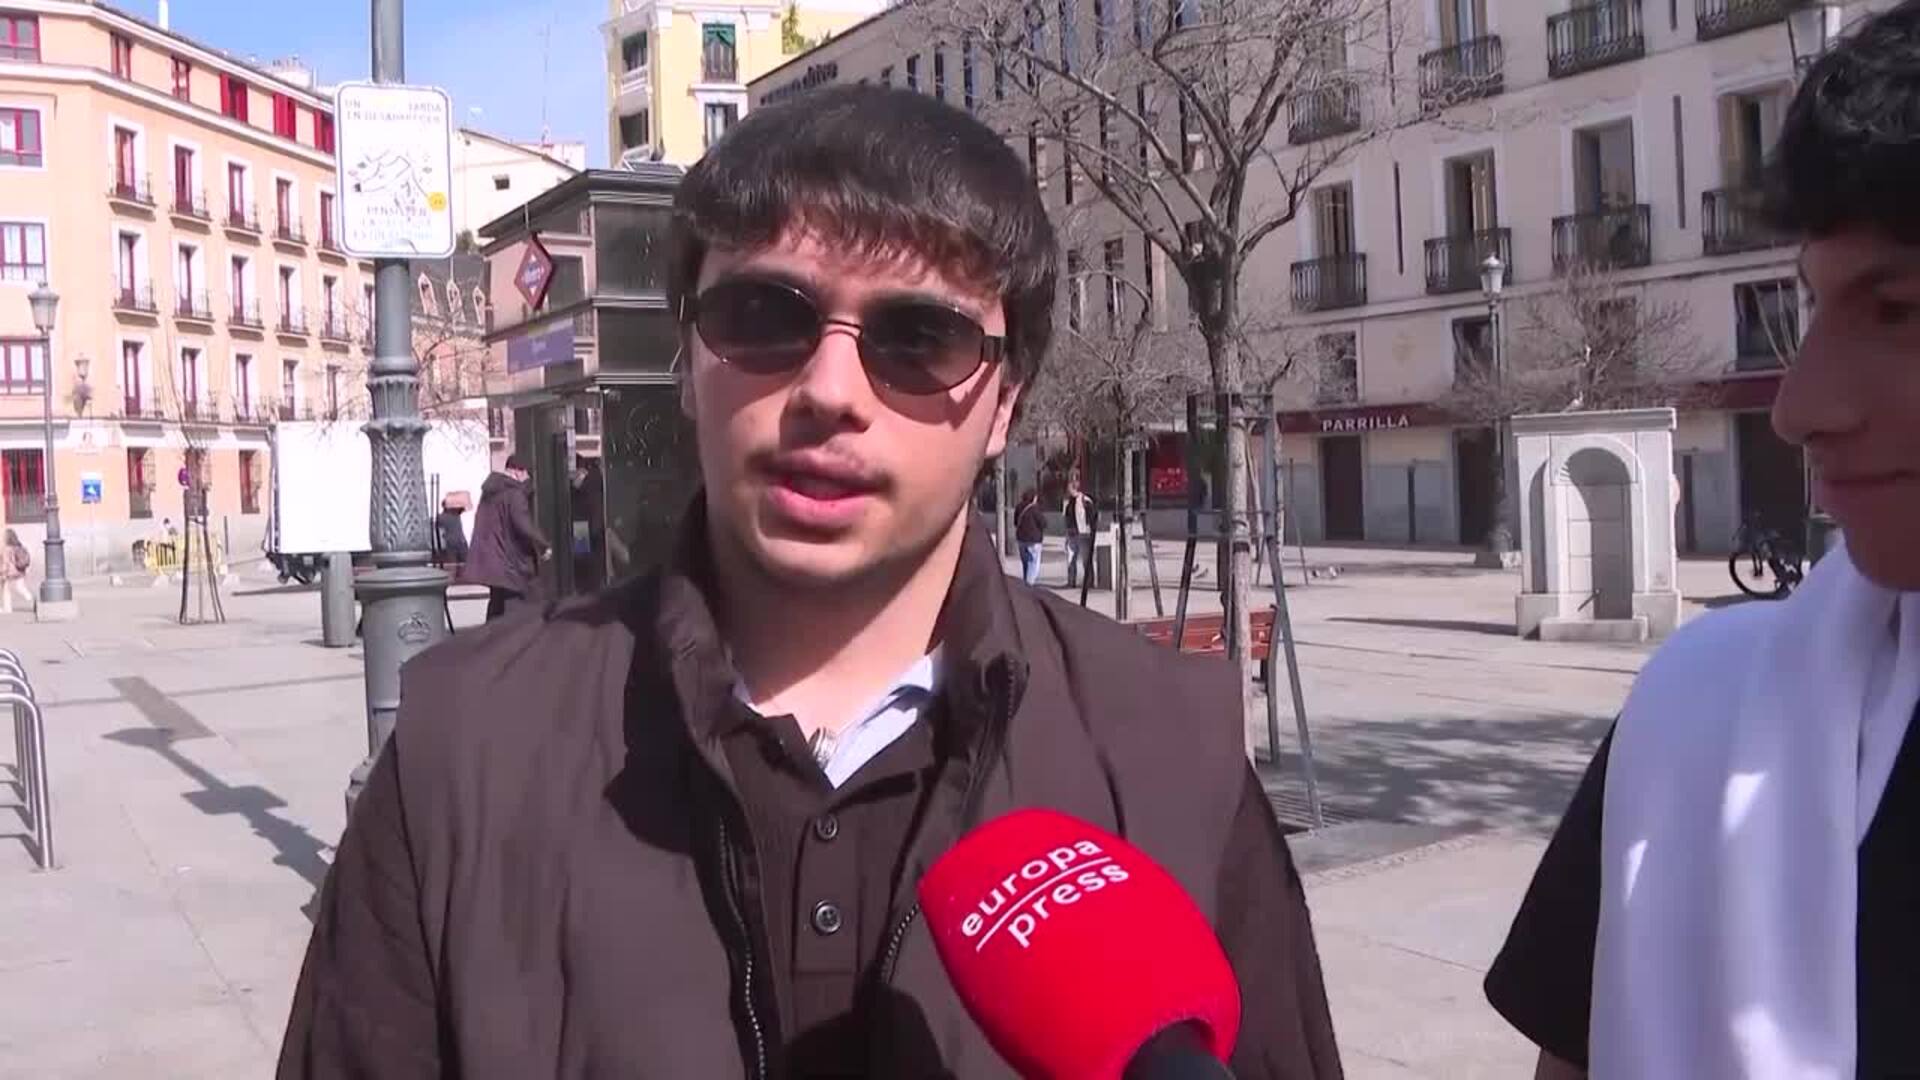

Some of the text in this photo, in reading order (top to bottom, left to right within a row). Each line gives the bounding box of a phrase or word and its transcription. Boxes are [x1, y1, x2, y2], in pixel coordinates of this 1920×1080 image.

[1322, 415, 1408, 432] PARRILLA
[962, 840, 1103, 936] europa
[1007, 864, 1129, 948] press
